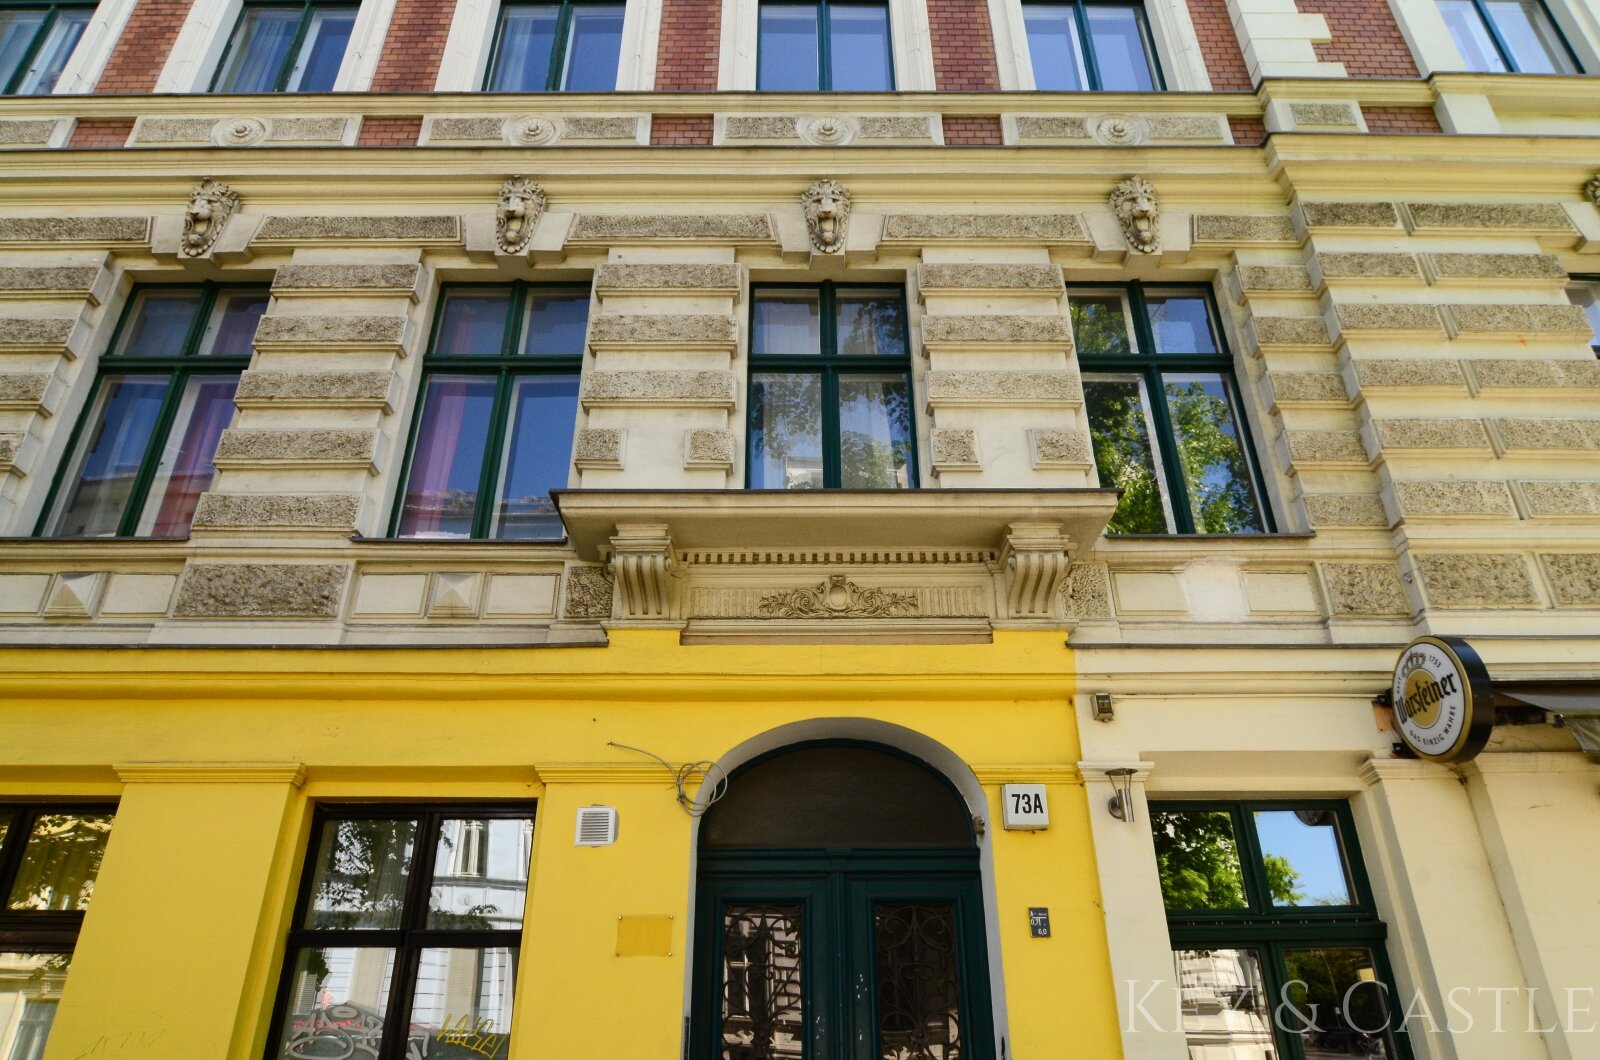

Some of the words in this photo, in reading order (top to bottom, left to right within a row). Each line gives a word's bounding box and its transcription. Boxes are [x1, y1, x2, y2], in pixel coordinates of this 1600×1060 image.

[1429, 655, 1442, 668] 1753
[1395, 673, 1457, 724] Warsteiner
[1423, 733, 1445, 746] EINZIG
[1443, 705, 1456, 735] WAHRE
[1011, 793, 1044, 814] 73A
